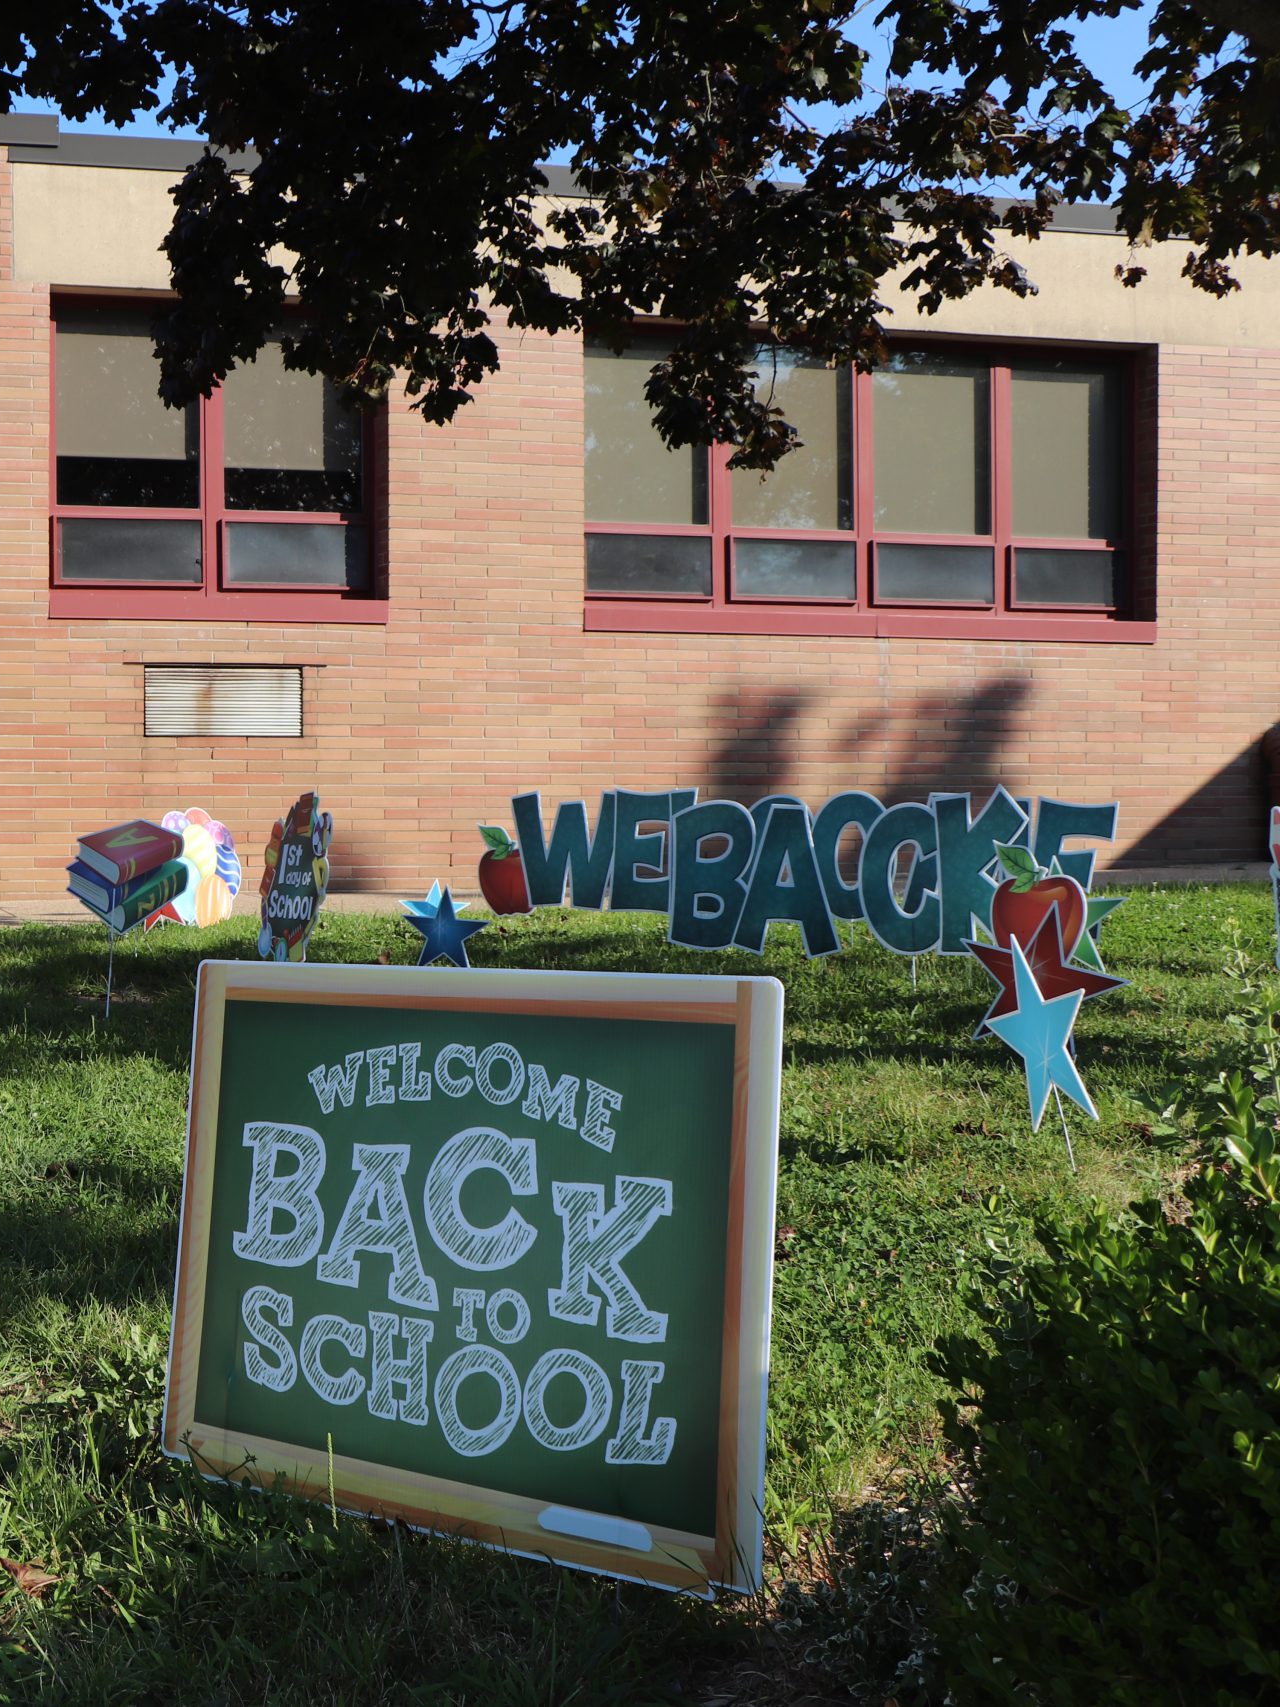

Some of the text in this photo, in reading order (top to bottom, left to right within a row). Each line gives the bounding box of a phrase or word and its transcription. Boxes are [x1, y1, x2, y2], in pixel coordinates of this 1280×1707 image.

[269, 889, 314, 921] School
[286, 871, 302, 888] day
[667, 783, 1030, 957] BACK
[308, 1042, 623, 1153] WELCOME
[233, 1121, 673, 1343] BACK
[452, 1287, 531, 1344] TO
[241, 1285, 677, 1465] SCHOOL
